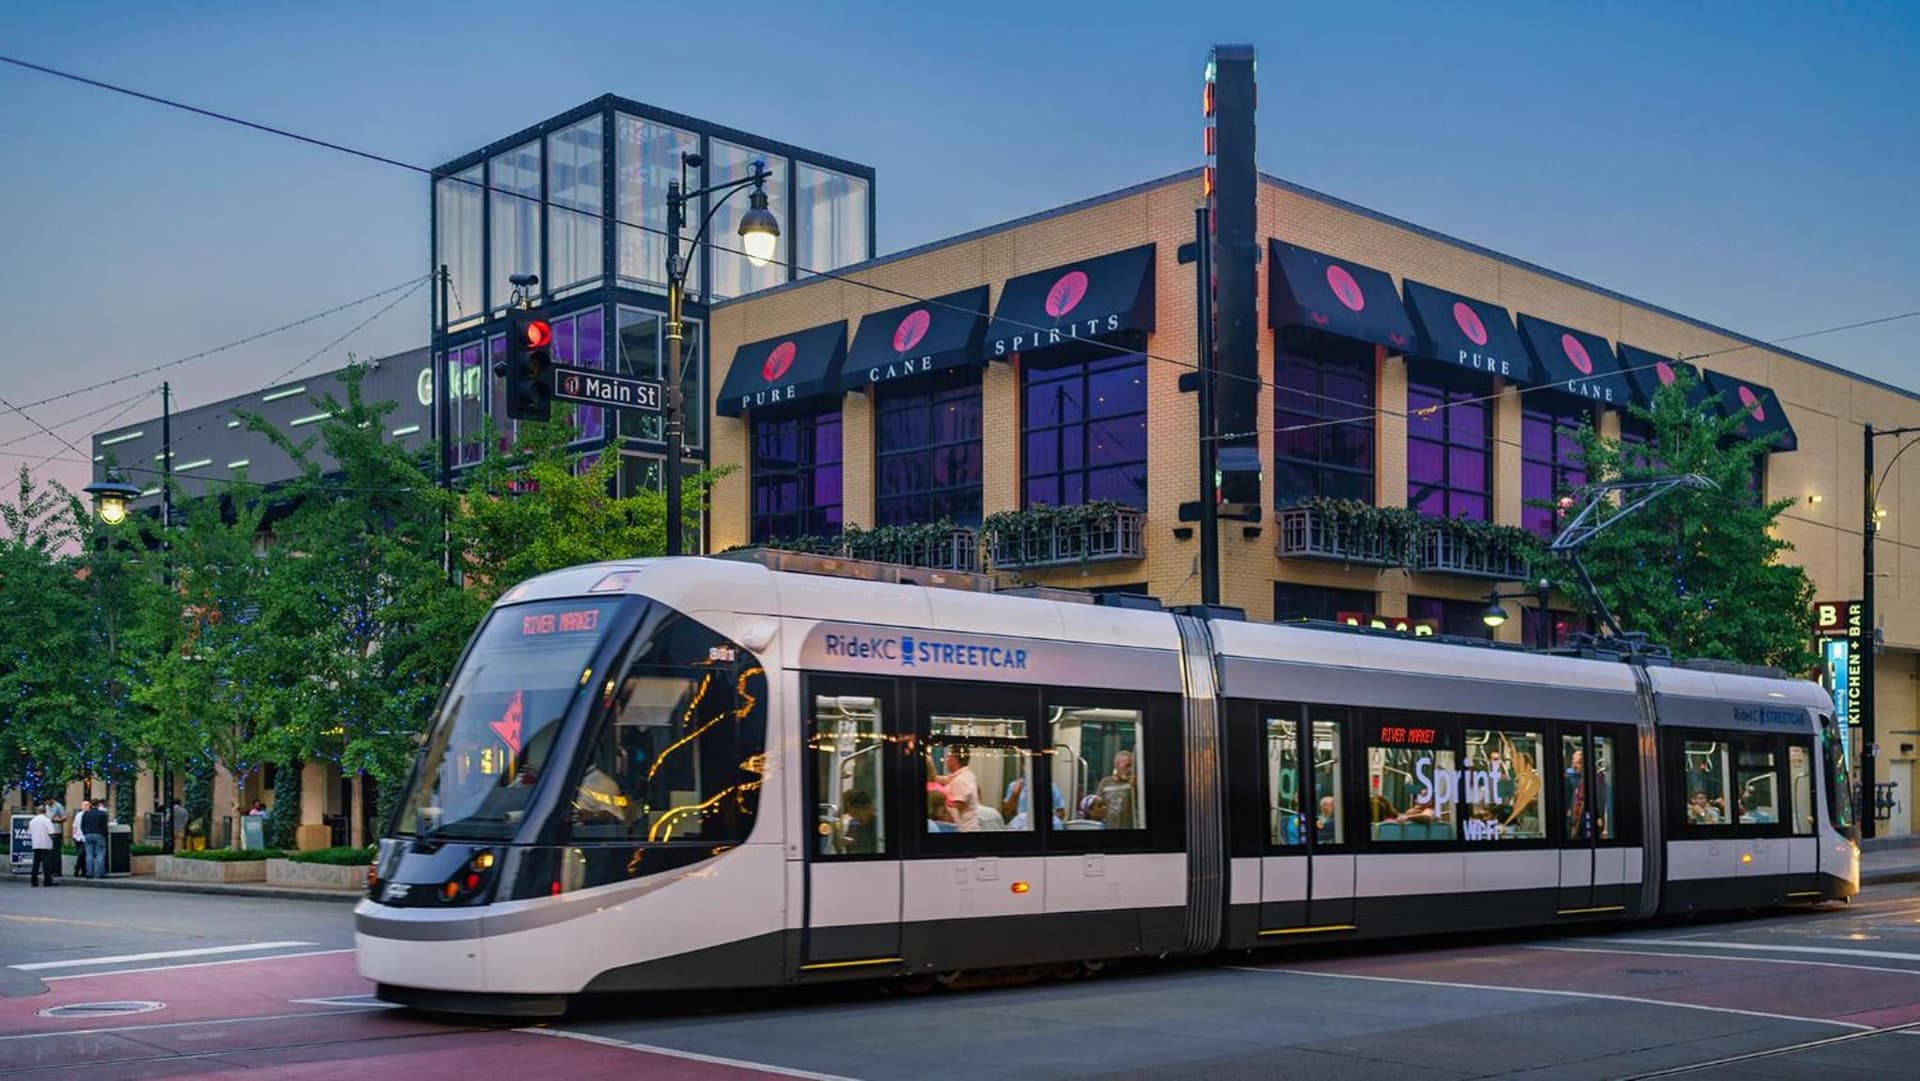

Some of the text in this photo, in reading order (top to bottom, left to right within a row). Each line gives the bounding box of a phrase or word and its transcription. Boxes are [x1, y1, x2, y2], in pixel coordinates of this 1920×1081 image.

[994, 313, 1119, 356] SPIRITS
[868, 355, 932, 382] CANE
[1458, 350, 1511, 376] PURE
[586, 377, 656, 406] Main St
[741, 384, 797, 409] PURE
[1567, 378, 1614, 402] CANE
[522, 609, 600, 636] RIVER MARKET
[1849, 604, 1861, 636] BAR
[825, 634, 1028, 670] RideKC STREETCAR
[1849, 655, 1861, 724] KITCHEN
[1380, 726, 1436, 744] RIVER MARKET
[1415, 756, 1504, 818] Sprint
